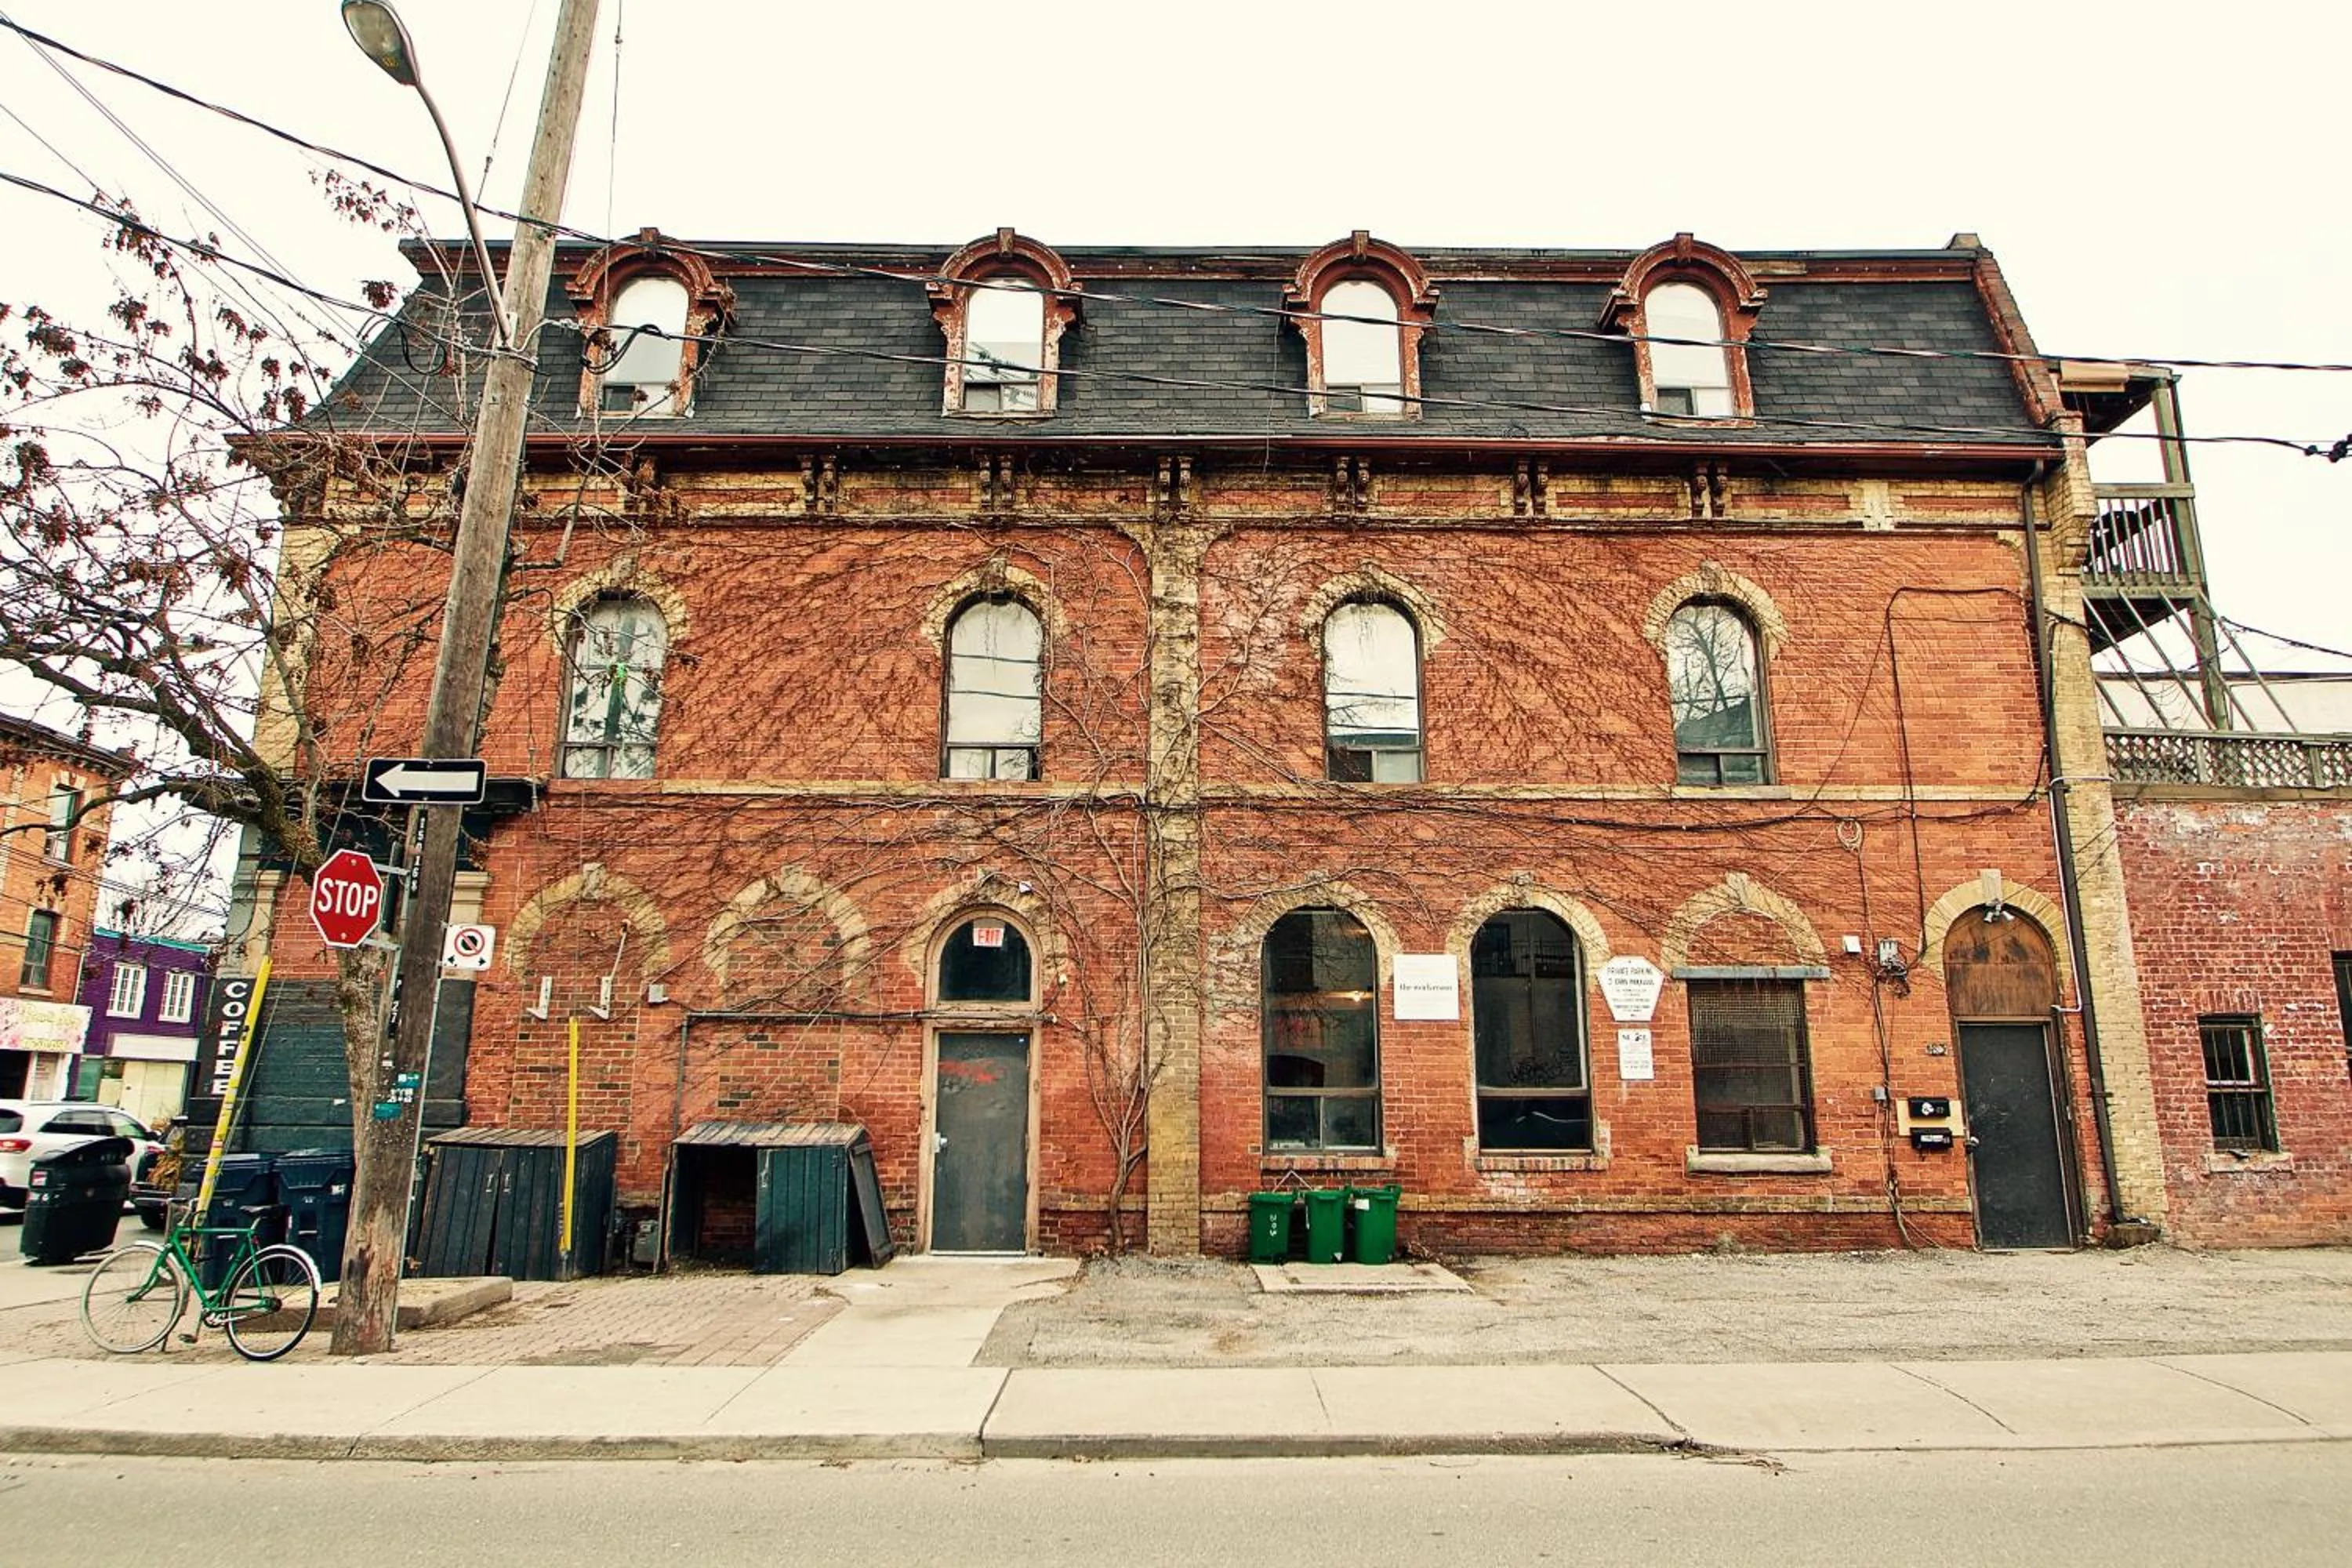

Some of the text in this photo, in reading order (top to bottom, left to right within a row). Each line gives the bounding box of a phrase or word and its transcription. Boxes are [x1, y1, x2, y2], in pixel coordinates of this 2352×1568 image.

[318, 877, 379, 918] STOP
[978, 929, 1000, 946] EXIT
[211, 981, 249, 1094] COFFEE
